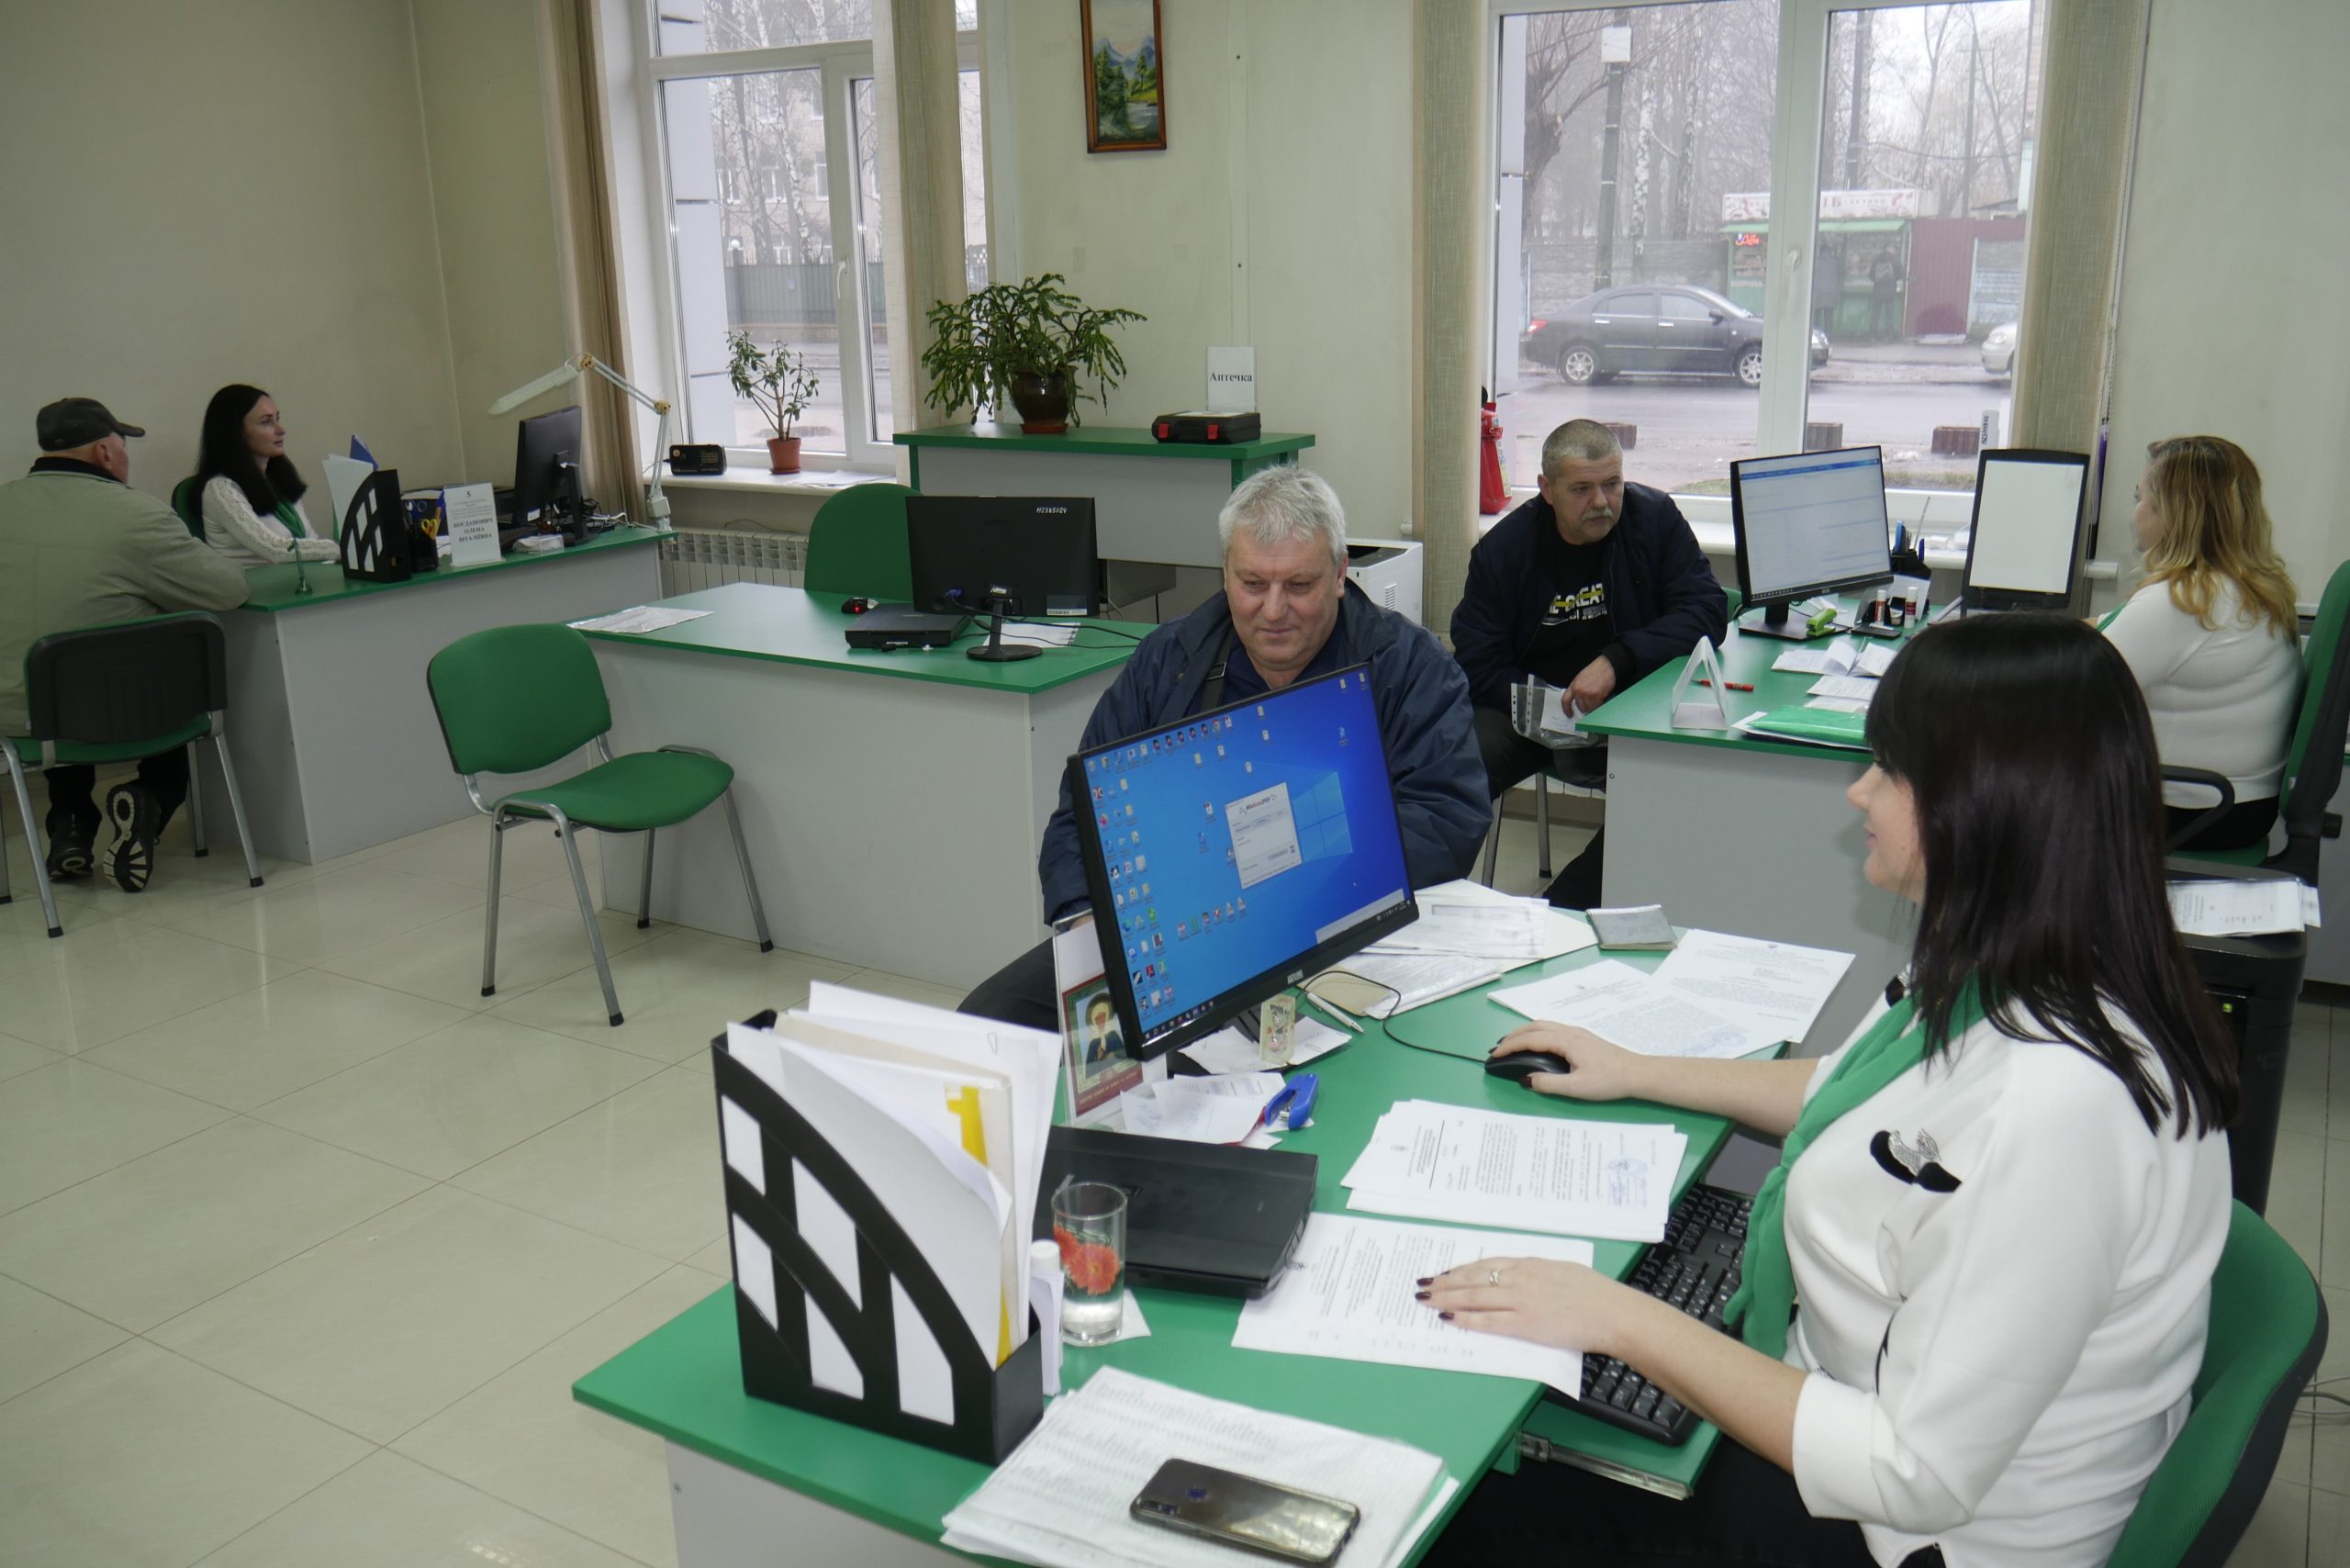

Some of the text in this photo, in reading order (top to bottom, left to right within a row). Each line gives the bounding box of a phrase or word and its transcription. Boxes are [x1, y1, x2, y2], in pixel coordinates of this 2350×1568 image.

[1209, 372, 1253, 382] Аптечка
[466, 490, 471, 498] 5
[453, 517, 494, 528] БОГДАНОВИЧ
